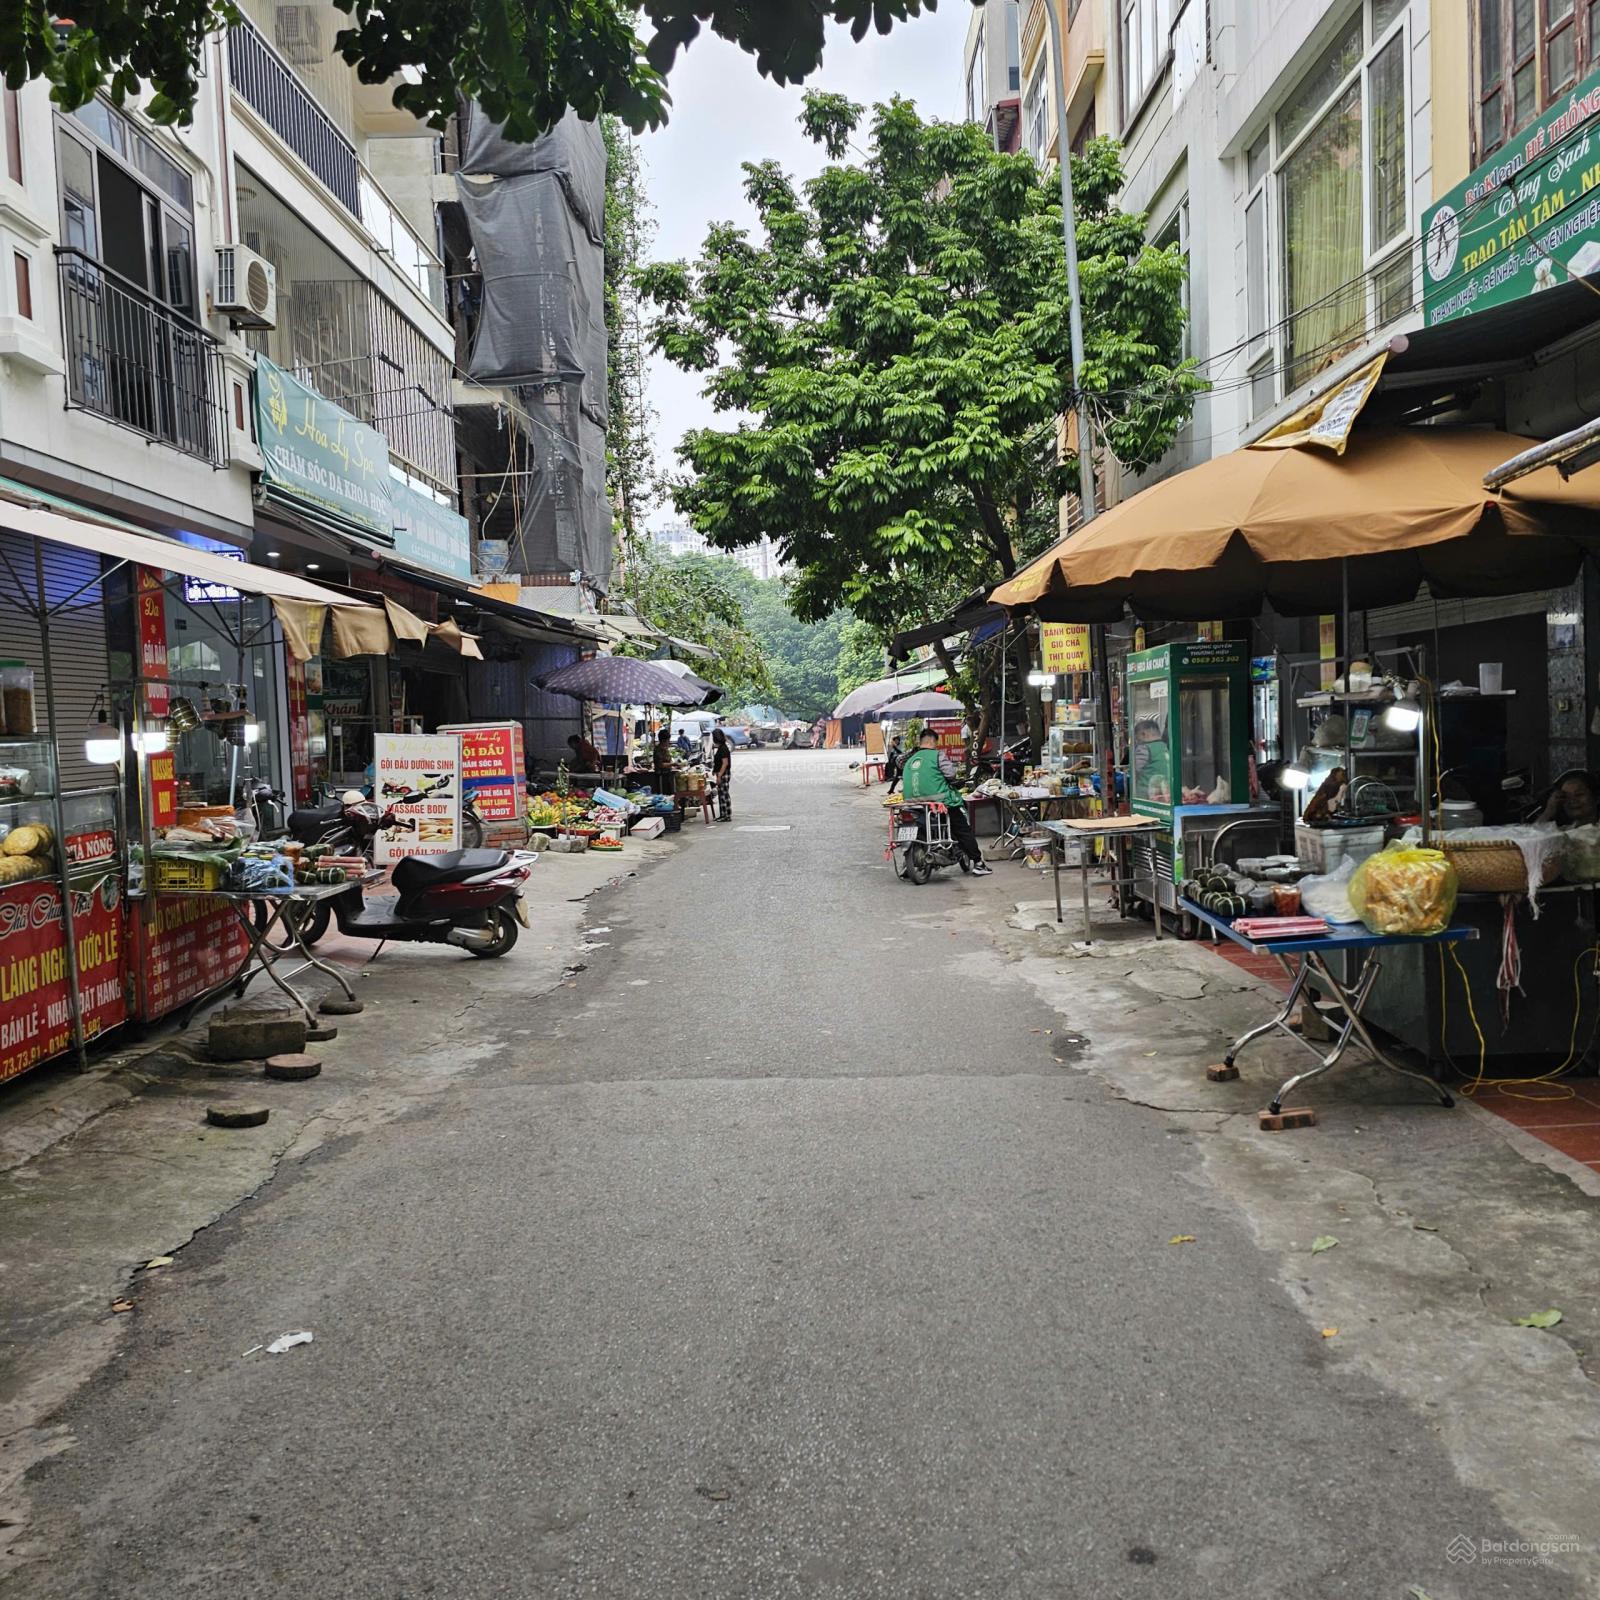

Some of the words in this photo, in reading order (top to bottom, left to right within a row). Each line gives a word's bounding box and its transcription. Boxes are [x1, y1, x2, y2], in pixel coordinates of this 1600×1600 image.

[1462, 238, 1497, 273] TRAO
[1532, 188, 1565, 228] TÂM
[1430, 297, 1457, 326] NHANH
[295, 397, 329, 449] Hoa
[330, 418, 350, 472] Ly
[352, 430, 375, 481] Spa
[274, 444, 306, 479] CHĂM
[306, 460, 328, 487] SÓC
[329, 471, 344, 496] DA
[344, 478, 370, 507] KHOA
[1066, 651, 1084, 660] QUAY
[463, 745, 476, 759] ỘI
[478, 743, 505, 756] ĐẦU
[380, 757, 393, 772] GỘI
[394, 757, 409, 770] ĐẦU
[436, 759, 454, 770] SINH
[462, 760, 477, 768] HĂM
[478, 759, 492, 767] SÓC
[427, 803, 448, 814] BODY
[491, 808, 511, 816] BODY
[86, 835, 113, 858] NÓNG
[389, 846, 405, 860] GỘI
[30, 893, 64, 930] Chun
[1, 955, 38, 1002] LÀNG
[41, 945, 70, 986] NGH
[79, 930, 102, 973] ƯỚC
[104, 918, 119, 963] LỄ
[1, 1015, 24, 1050] BÁN
[26, 1003, 39, 1039] LẺ
[96, 977, 121, 1007] HÀNG
